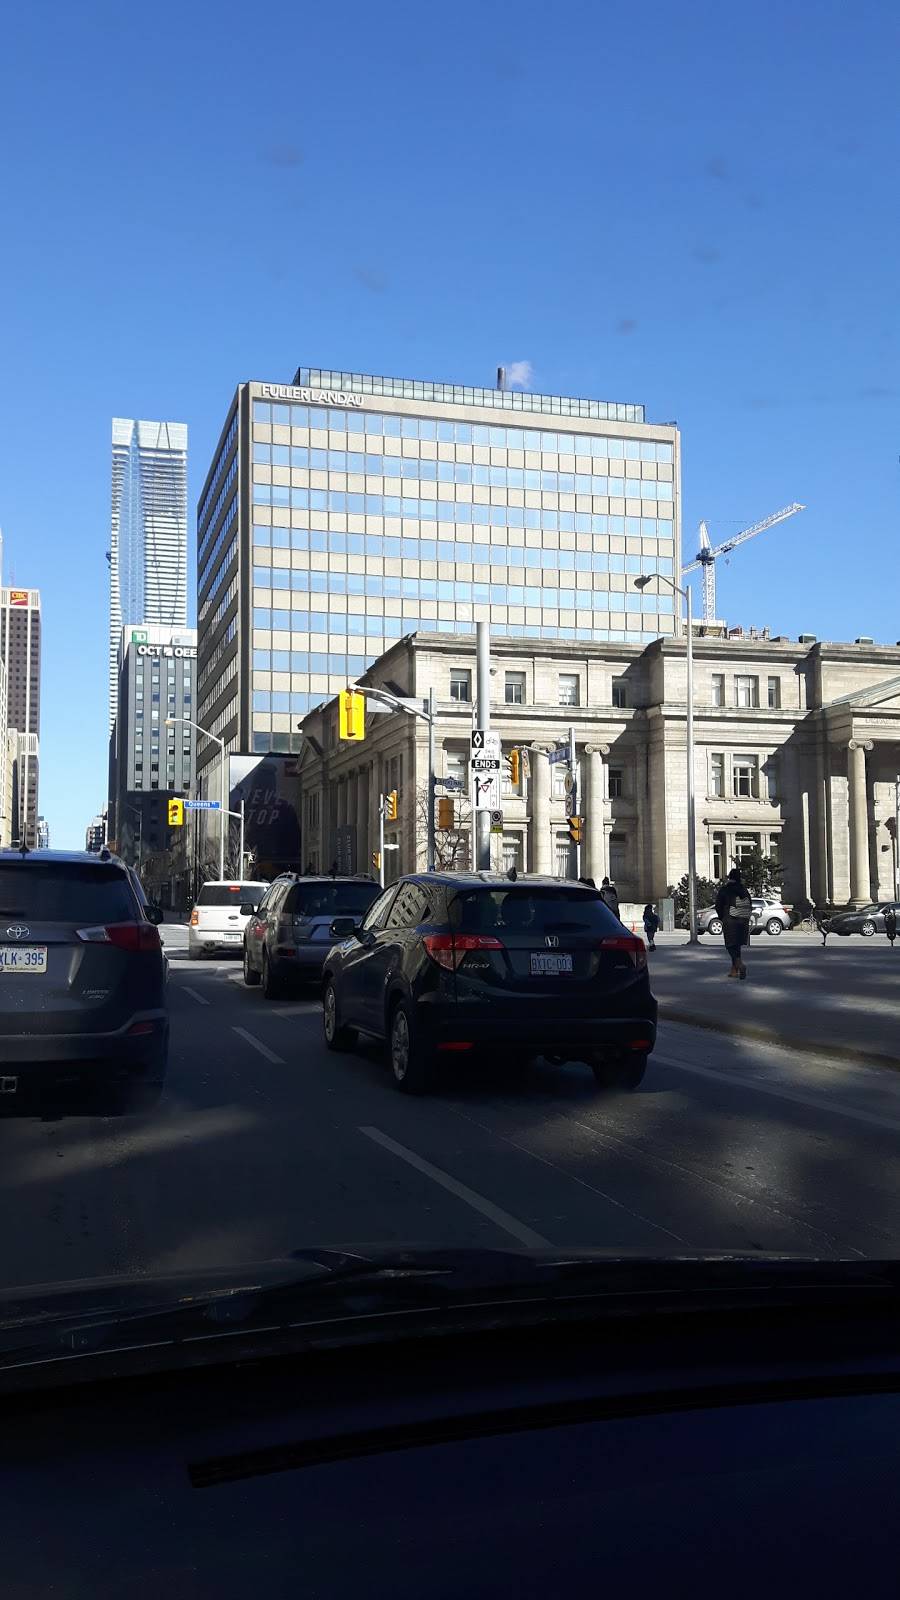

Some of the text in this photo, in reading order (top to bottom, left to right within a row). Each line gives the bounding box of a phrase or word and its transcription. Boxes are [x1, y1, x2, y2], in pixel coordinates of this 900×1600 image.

[262, 384, 365, 407] FULLER LANDAU
[138, 645, 162, 657] OCT
[475, 760, 497, 769] ENDS
[246, 809, 280, 825] TOP
[24, 952, 44, 966] 395
